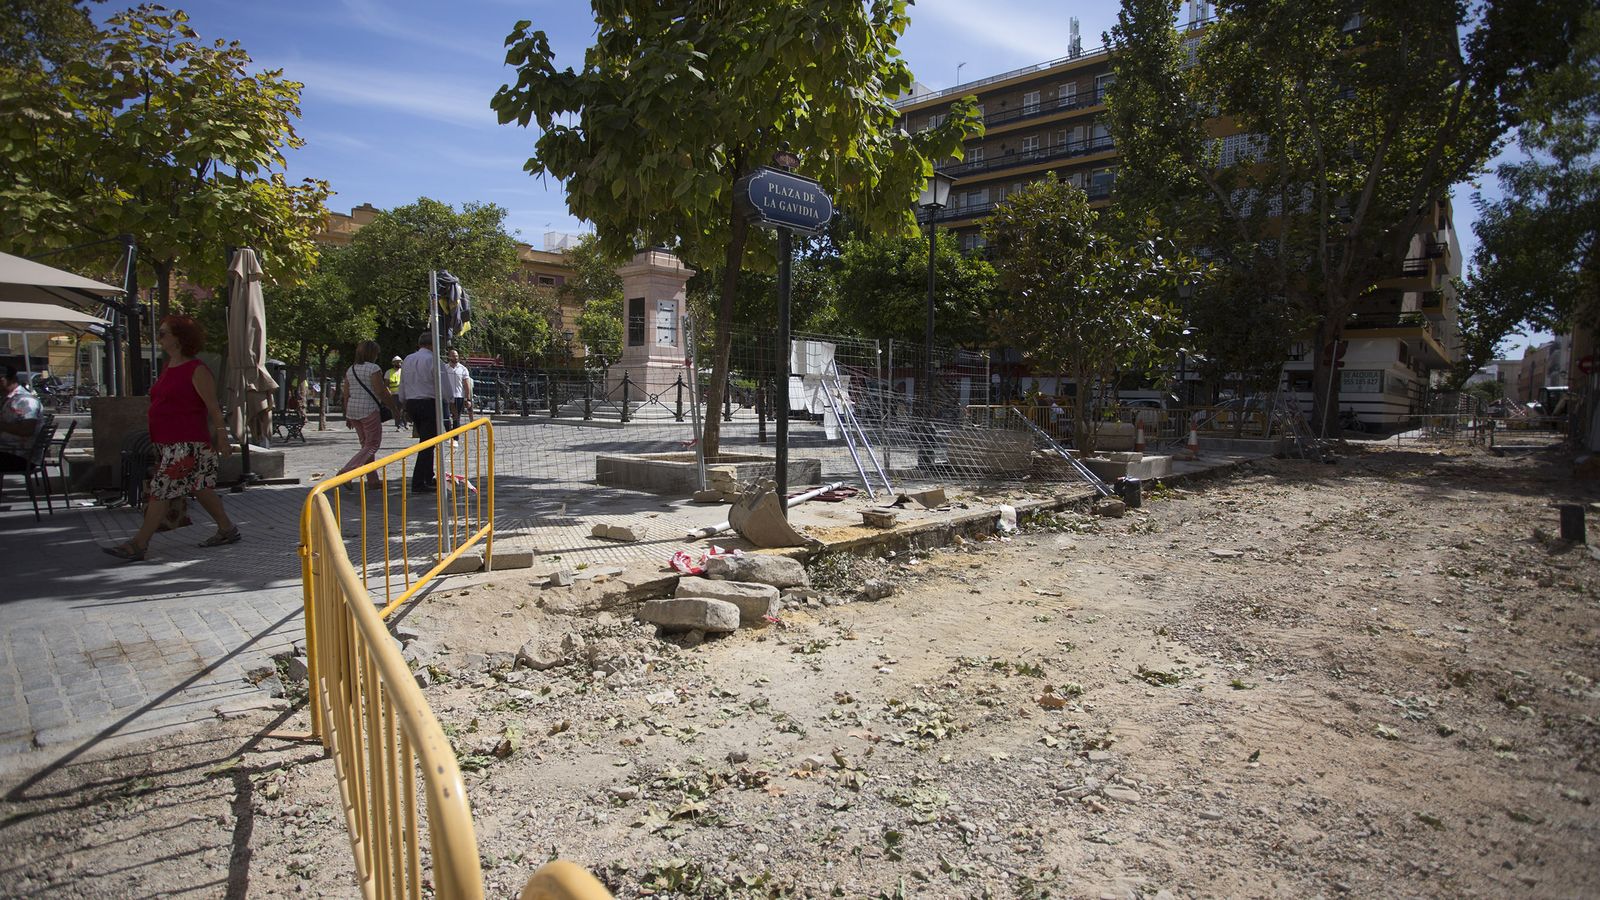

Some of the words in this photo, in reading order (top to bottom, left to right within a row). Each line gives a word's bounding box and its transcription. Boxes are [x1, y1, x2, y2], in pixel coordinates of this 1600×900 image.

[768, 182, 801, 200] PLAZA
[803, 192, 816, 204] DE
[763, 196, 776, 208] LA
[779, 200, 819, 219] GAVIDIA
[1352, 371, 1378, 379] ALQUILA
